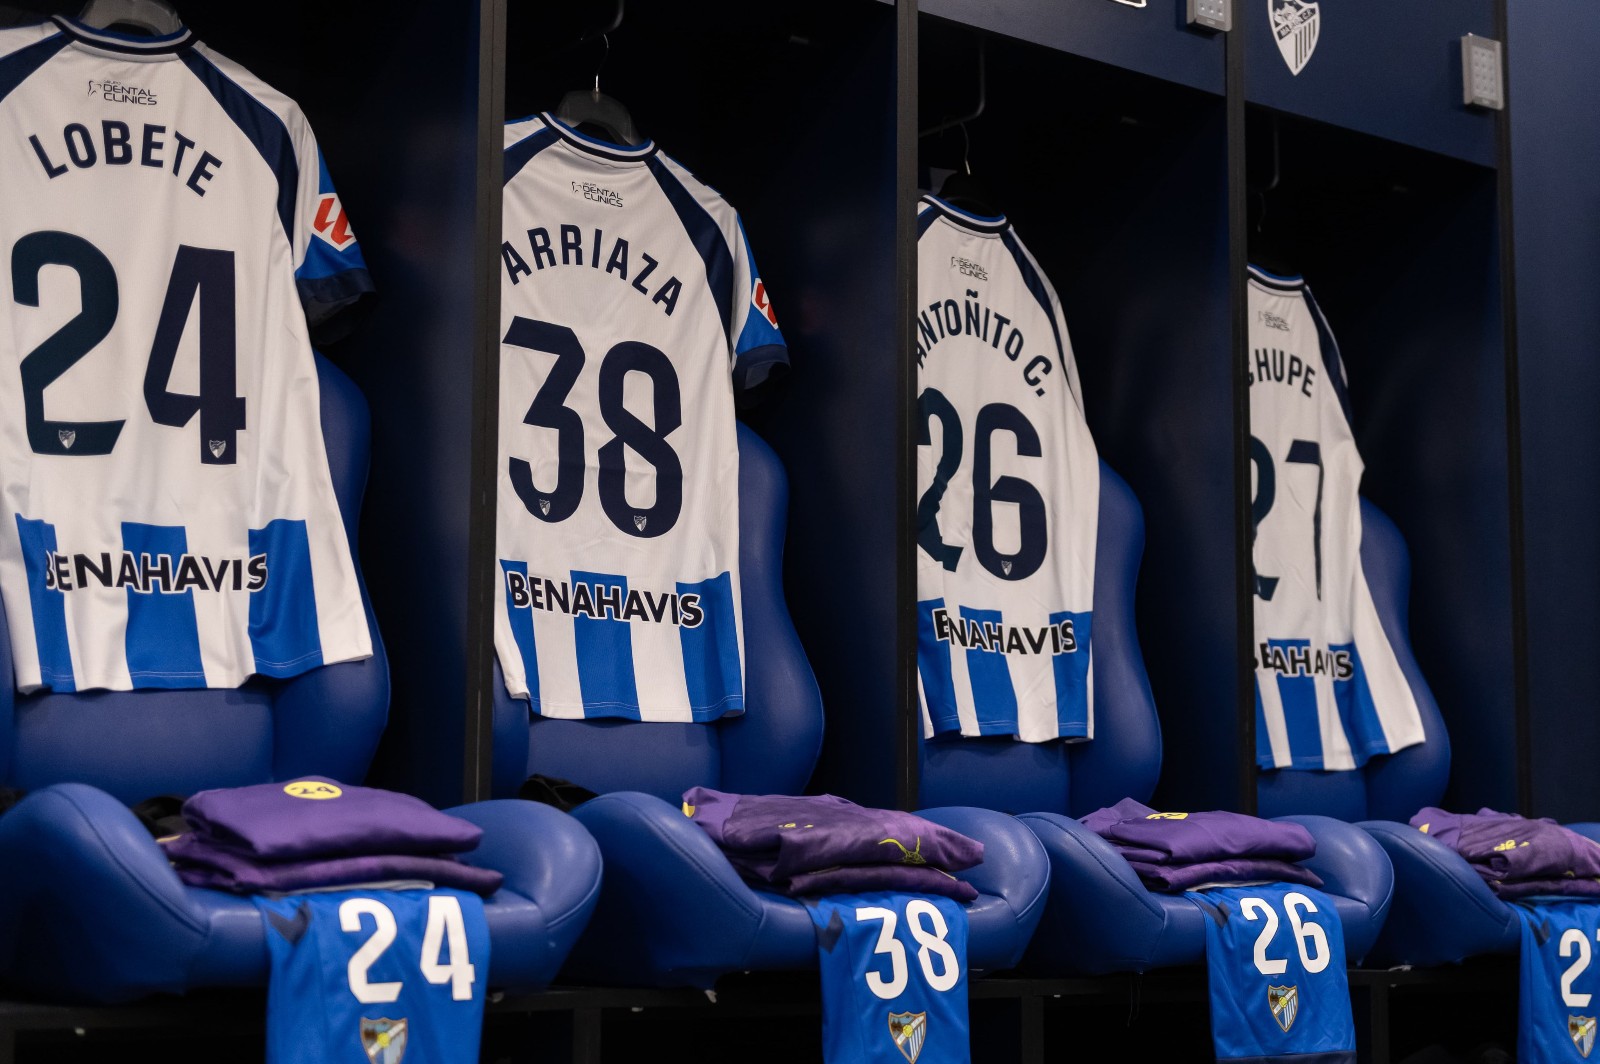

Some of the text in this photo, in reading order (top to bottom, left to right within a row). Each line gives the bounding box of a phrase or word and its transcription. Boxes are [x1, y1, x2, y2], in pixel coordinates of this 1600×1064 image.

[103, 83, 157, 97] DENTAL
[103, 92, 158, 106] CLINICS
[28, 119, 223, 198] LOBETE
[583, 185, 624, 200] DENTAL
[584, 192, 623, 208] CLINICS
[502, 223, 683, 317] ARRIAZA
[11, 229, 247, 466] 24
[1023, 355, 1053, 398] C.
[501, 315, 684, 539] 38
[917, 387, 1048, 582] 26
[508, 570, 705, 628] BENAHAVIS
[338, 895, 476, 1004] 24
[855, 899, 960, 1000] 38
[1239, 892, 1331, 975] 26
[1558, 928, 1600, 1008] 2
